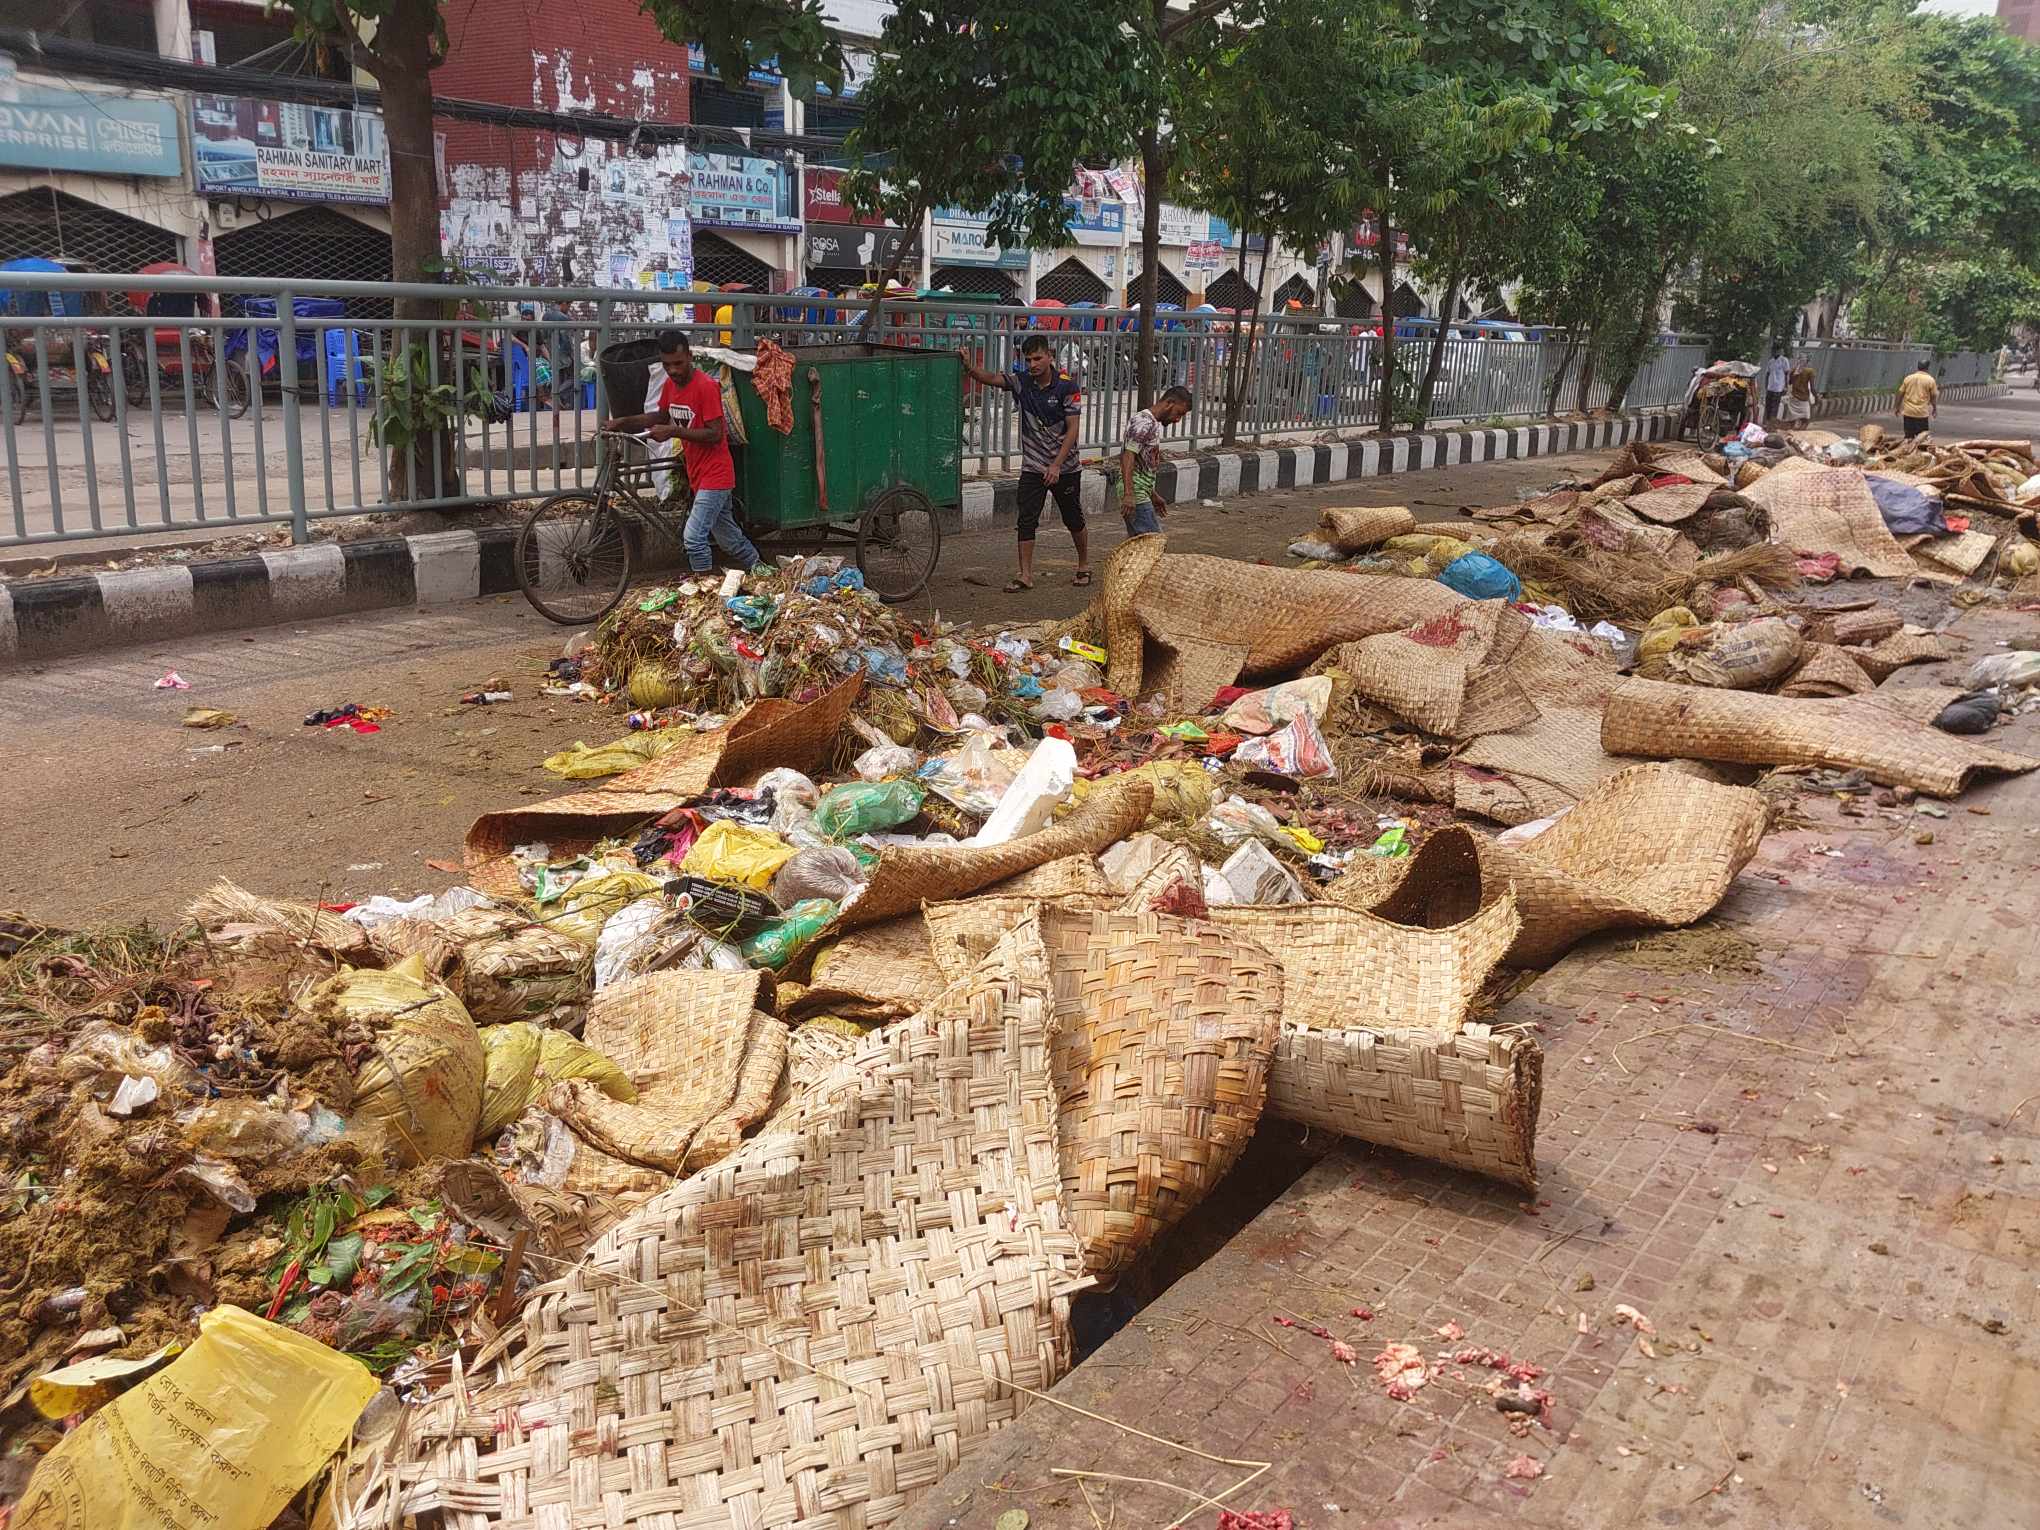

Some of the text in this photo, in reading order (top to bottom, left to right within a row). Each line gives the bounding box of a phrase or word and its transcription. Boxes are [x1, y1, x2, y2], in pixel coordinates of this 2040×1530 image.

[257, 148, 382, 174] RAHMAN SANITARY MART
[698, 172, 743, 192] RAHMAN
[746, 178, 753, 191] &
[812, 236, 840, 251] ROSA
[159, 1374, 217, 1425] রোধ করুন
[161, 1476, 191, 1507] নিশ্চিত
